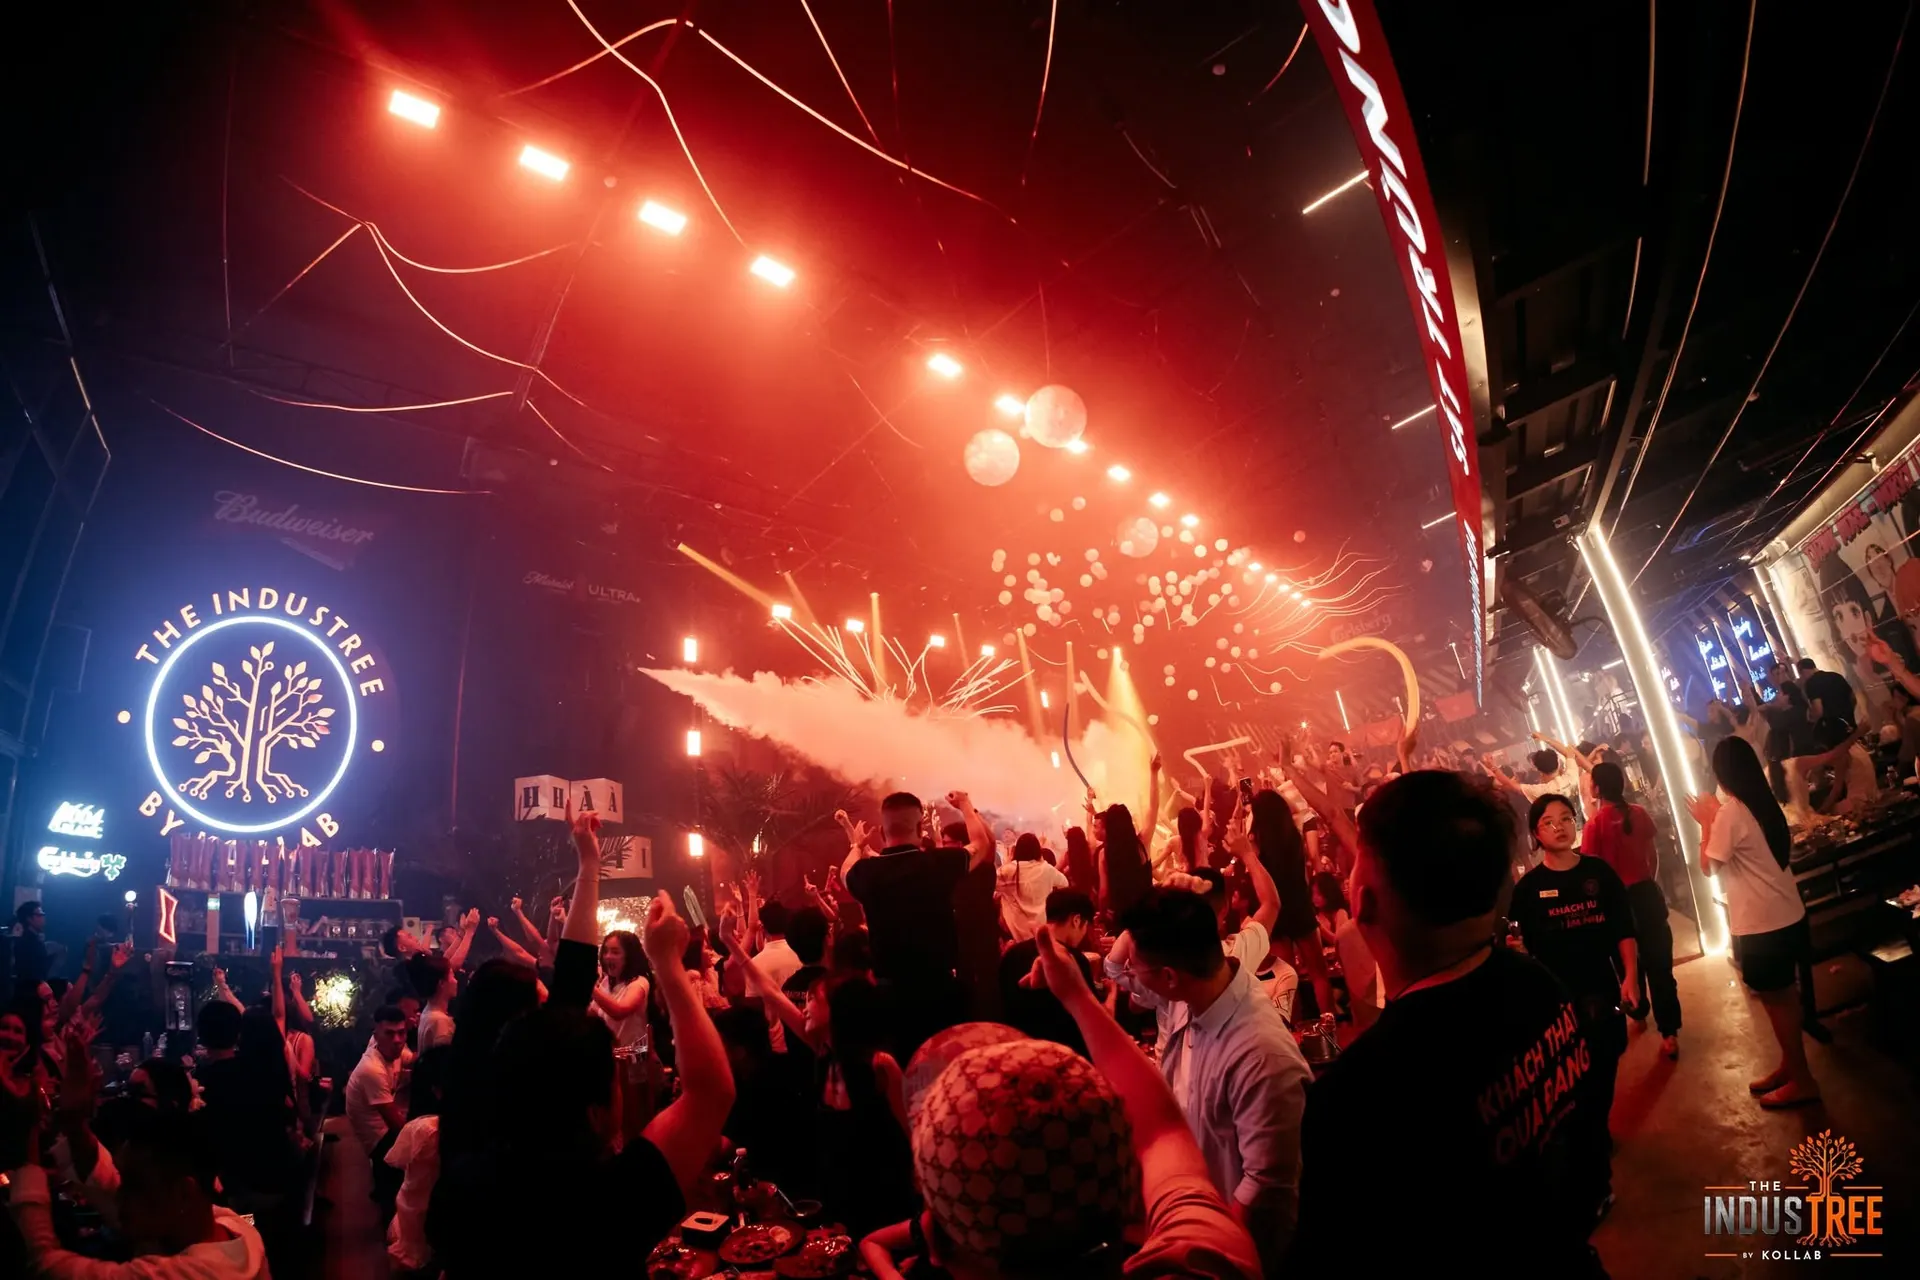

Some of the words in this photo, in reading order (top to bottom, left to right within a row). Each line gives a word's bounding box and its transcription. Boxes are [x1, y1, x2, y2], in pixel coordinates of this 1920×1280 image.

[213, 490, 375, 546] Budweiser
[588, 583, 637, 602] ULTRA
[135, 604, 202, 665] THE
[211, 587, 385, 697] INDUSTREE
[1330, 610, 1392, 645] Carlsberg
[138, 790, 185, 837] BY
[1475, 1039, 1545, 1125] KHÁCH
